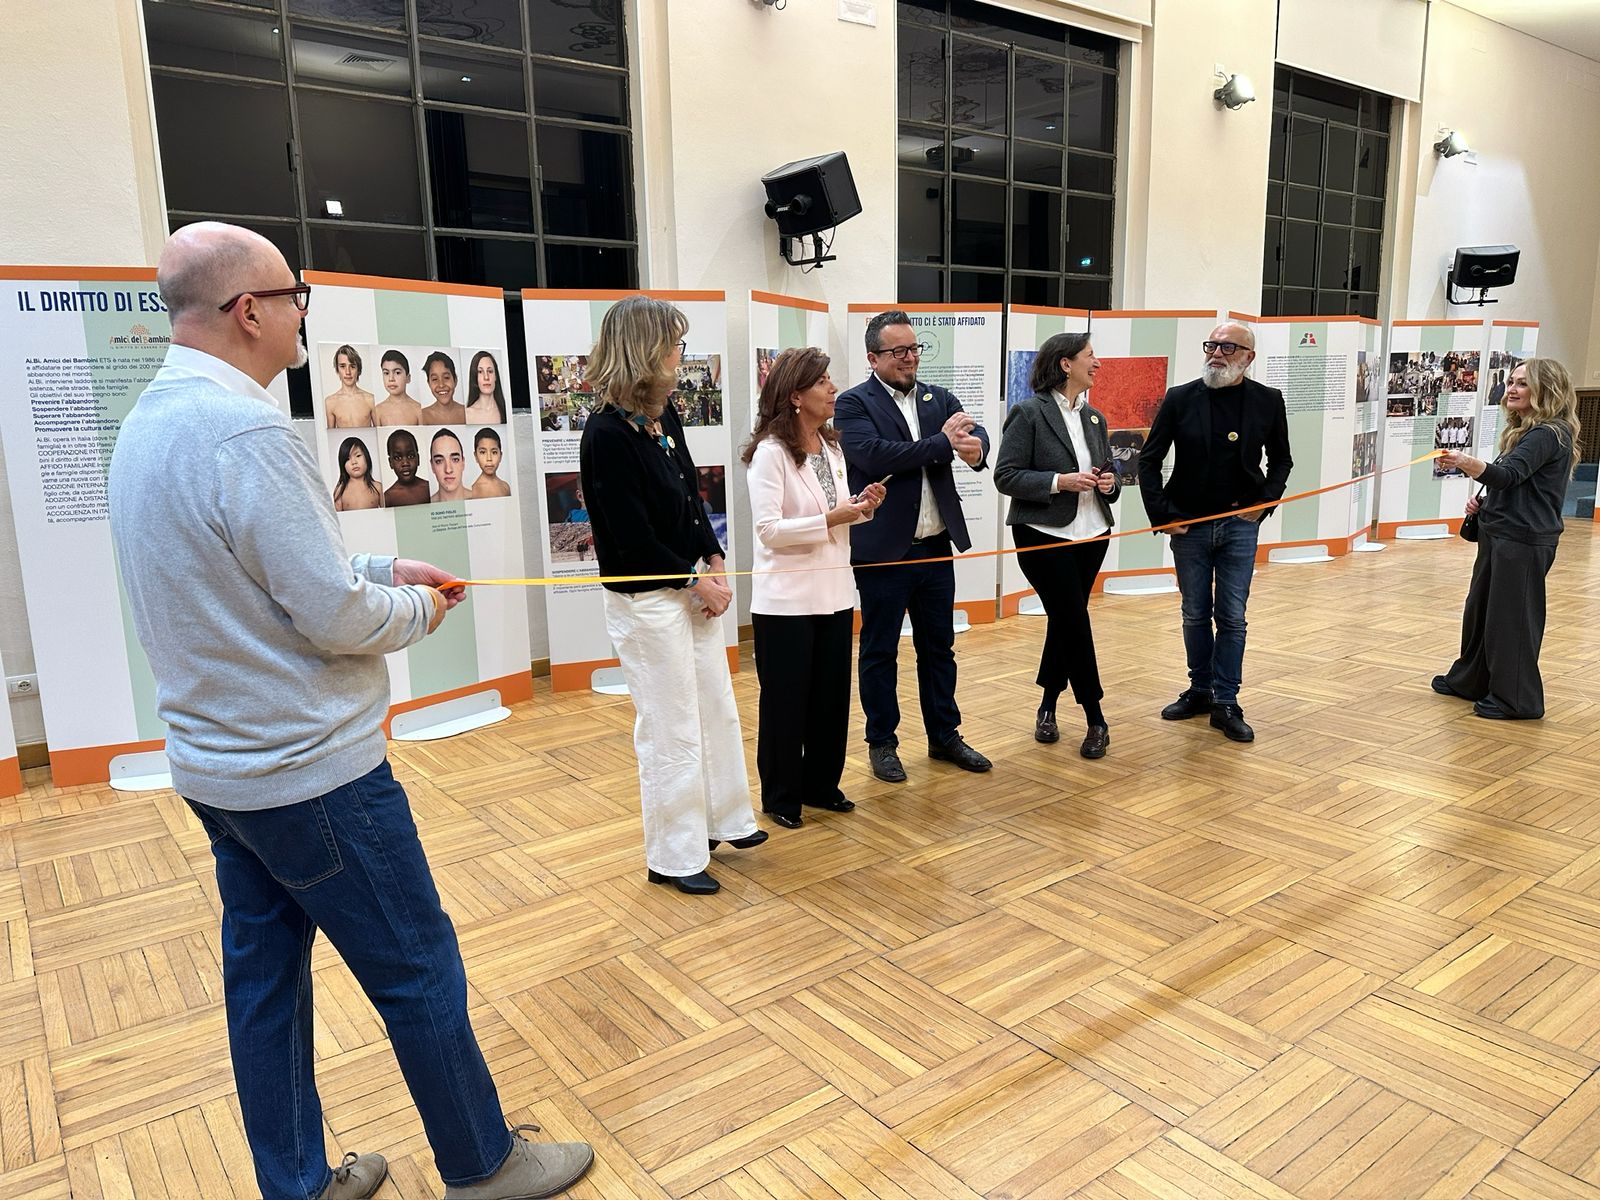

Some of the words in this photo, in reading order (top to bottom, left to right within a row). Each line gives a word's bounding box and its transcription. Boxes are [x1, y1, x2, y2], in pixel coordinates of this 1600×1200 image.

[18, 291, 35, 312] IL
[40, 291, 109, 312] DIRITTO
[114, 292, 132, 312] DI
[924, 317, 931, 326] CI
[933, 316, 936, 326] È
[938, 316, 956, 326] STATO
[957, 316, 986, 326] AFFIDATO
[143, 335, 171, 344] Bambin
